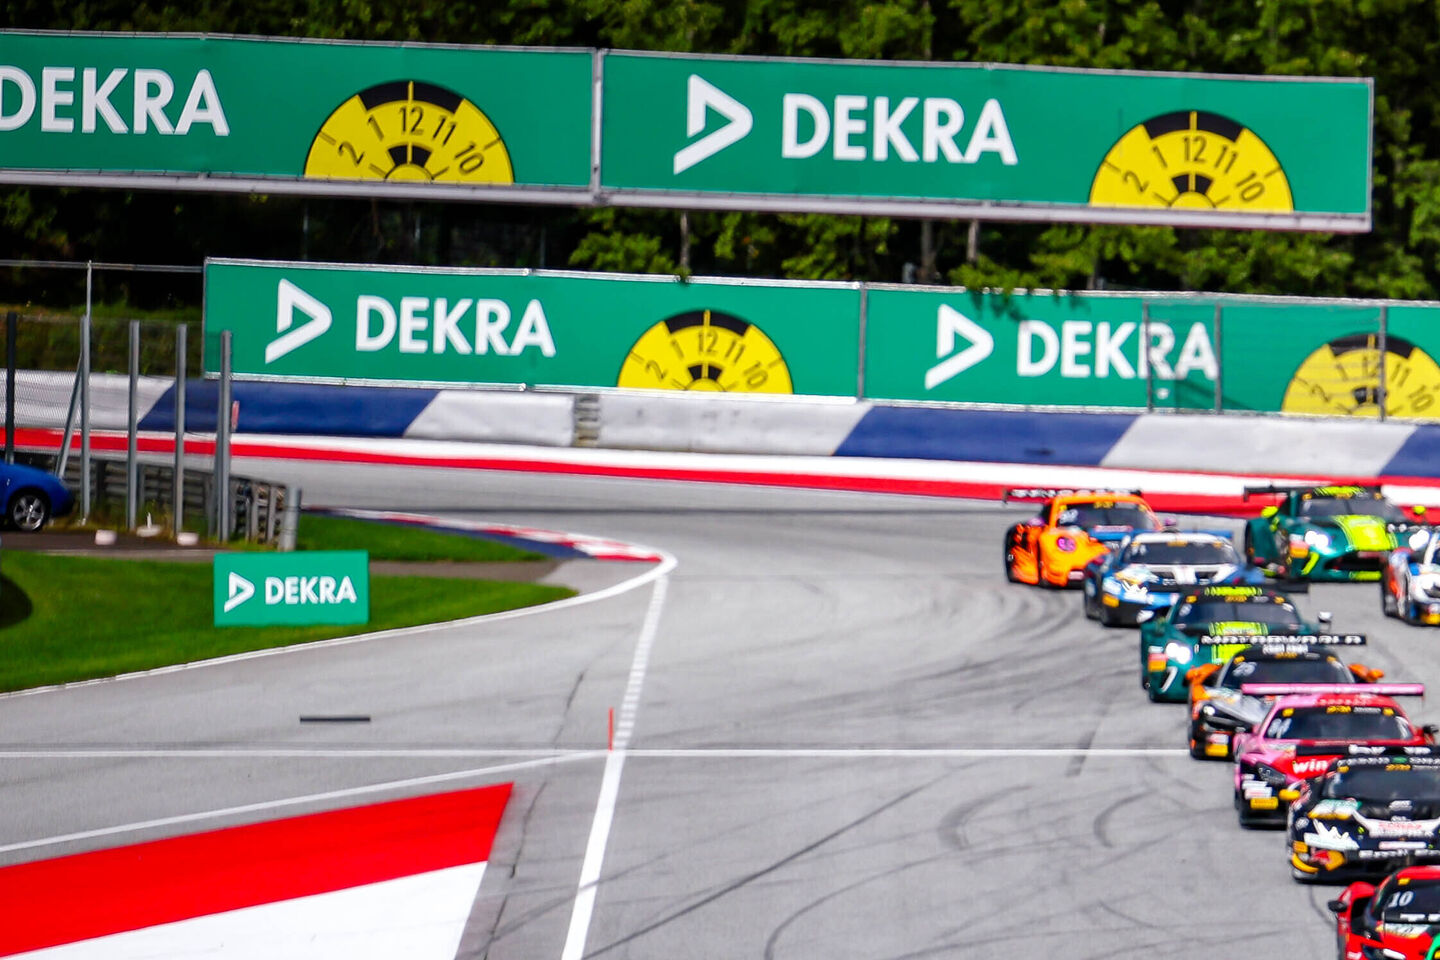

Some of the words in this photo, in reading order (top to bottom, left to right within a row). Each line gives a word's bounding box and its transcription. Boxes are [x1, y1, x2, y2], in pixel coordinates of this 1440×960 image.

[0, 66, 230, 136] DEKRA
[782, 93, 1018, 165] DEKRA
[337, 141, 365, 167] 2
[398, 105, 424, 136] 12
[432, 114, 457, 147] 11
[456, 142, 485, 177] 10
[1123, 170, 1149, 194] 2
[1183, 136, 1207, 165] 12
[1214, 145, 1238, 175] 11
[1237, 172, 1266, 204] 10
[355, 295, 557, 358] DEKRA
[1017, 320, 1219, 381] DEKRA
[645, 359, 668, 383] 2
[697, 332, 718, 357] 12
[725, 338, 745, 365] 11
[744, 360, 769, 388] 10
[265, 576, 358, 605] DEKRA
[1387, 891, 1415, 908] 10
